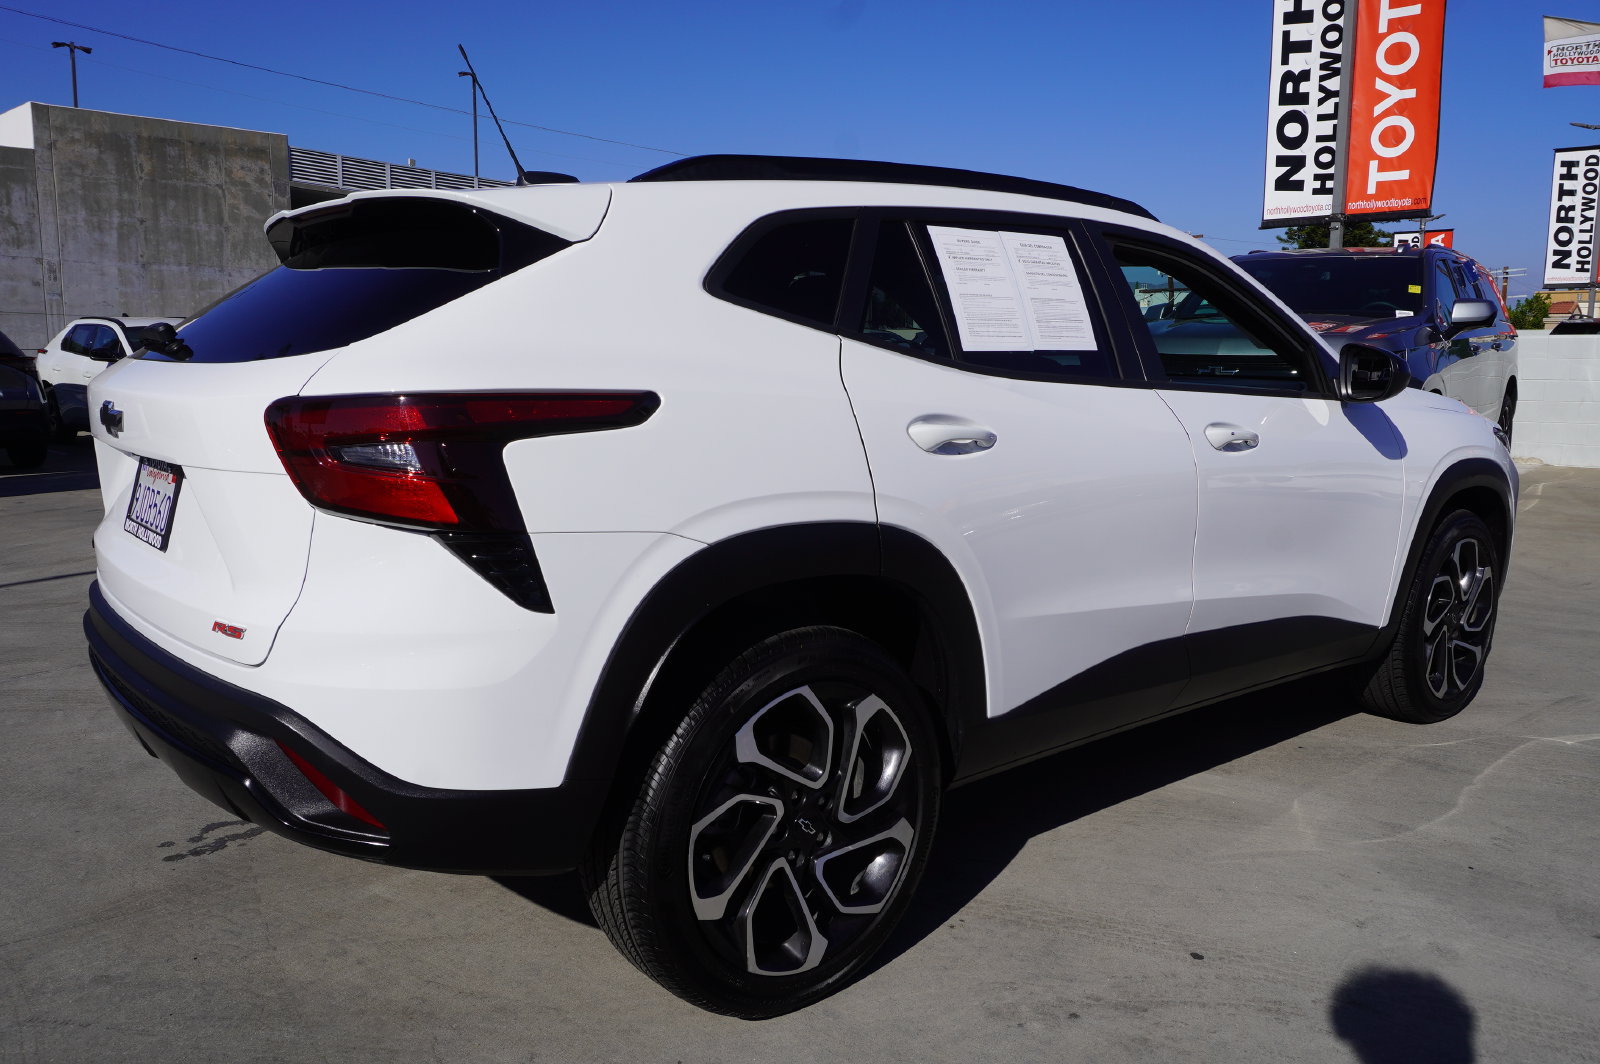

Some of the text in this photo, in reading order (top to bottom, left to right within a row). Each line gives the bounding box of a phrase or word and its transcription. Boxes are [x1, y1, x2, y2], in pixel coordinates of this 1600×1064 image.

[1552, 48, 1600, 58] HOLLYWOOD
[1552, 56, 1599, 65] TOYOTA
[1556, 42, 1600, 52] NORTH
[1274, 0, 1314, 191] NORTH
[1366, 0, 1422, 195] TOYOT
[1552, 160, 1580, 270] NORTH
[1575, 154, 1600, 273] HOLLYWOOD
[211, 620, 247, 640] RS
